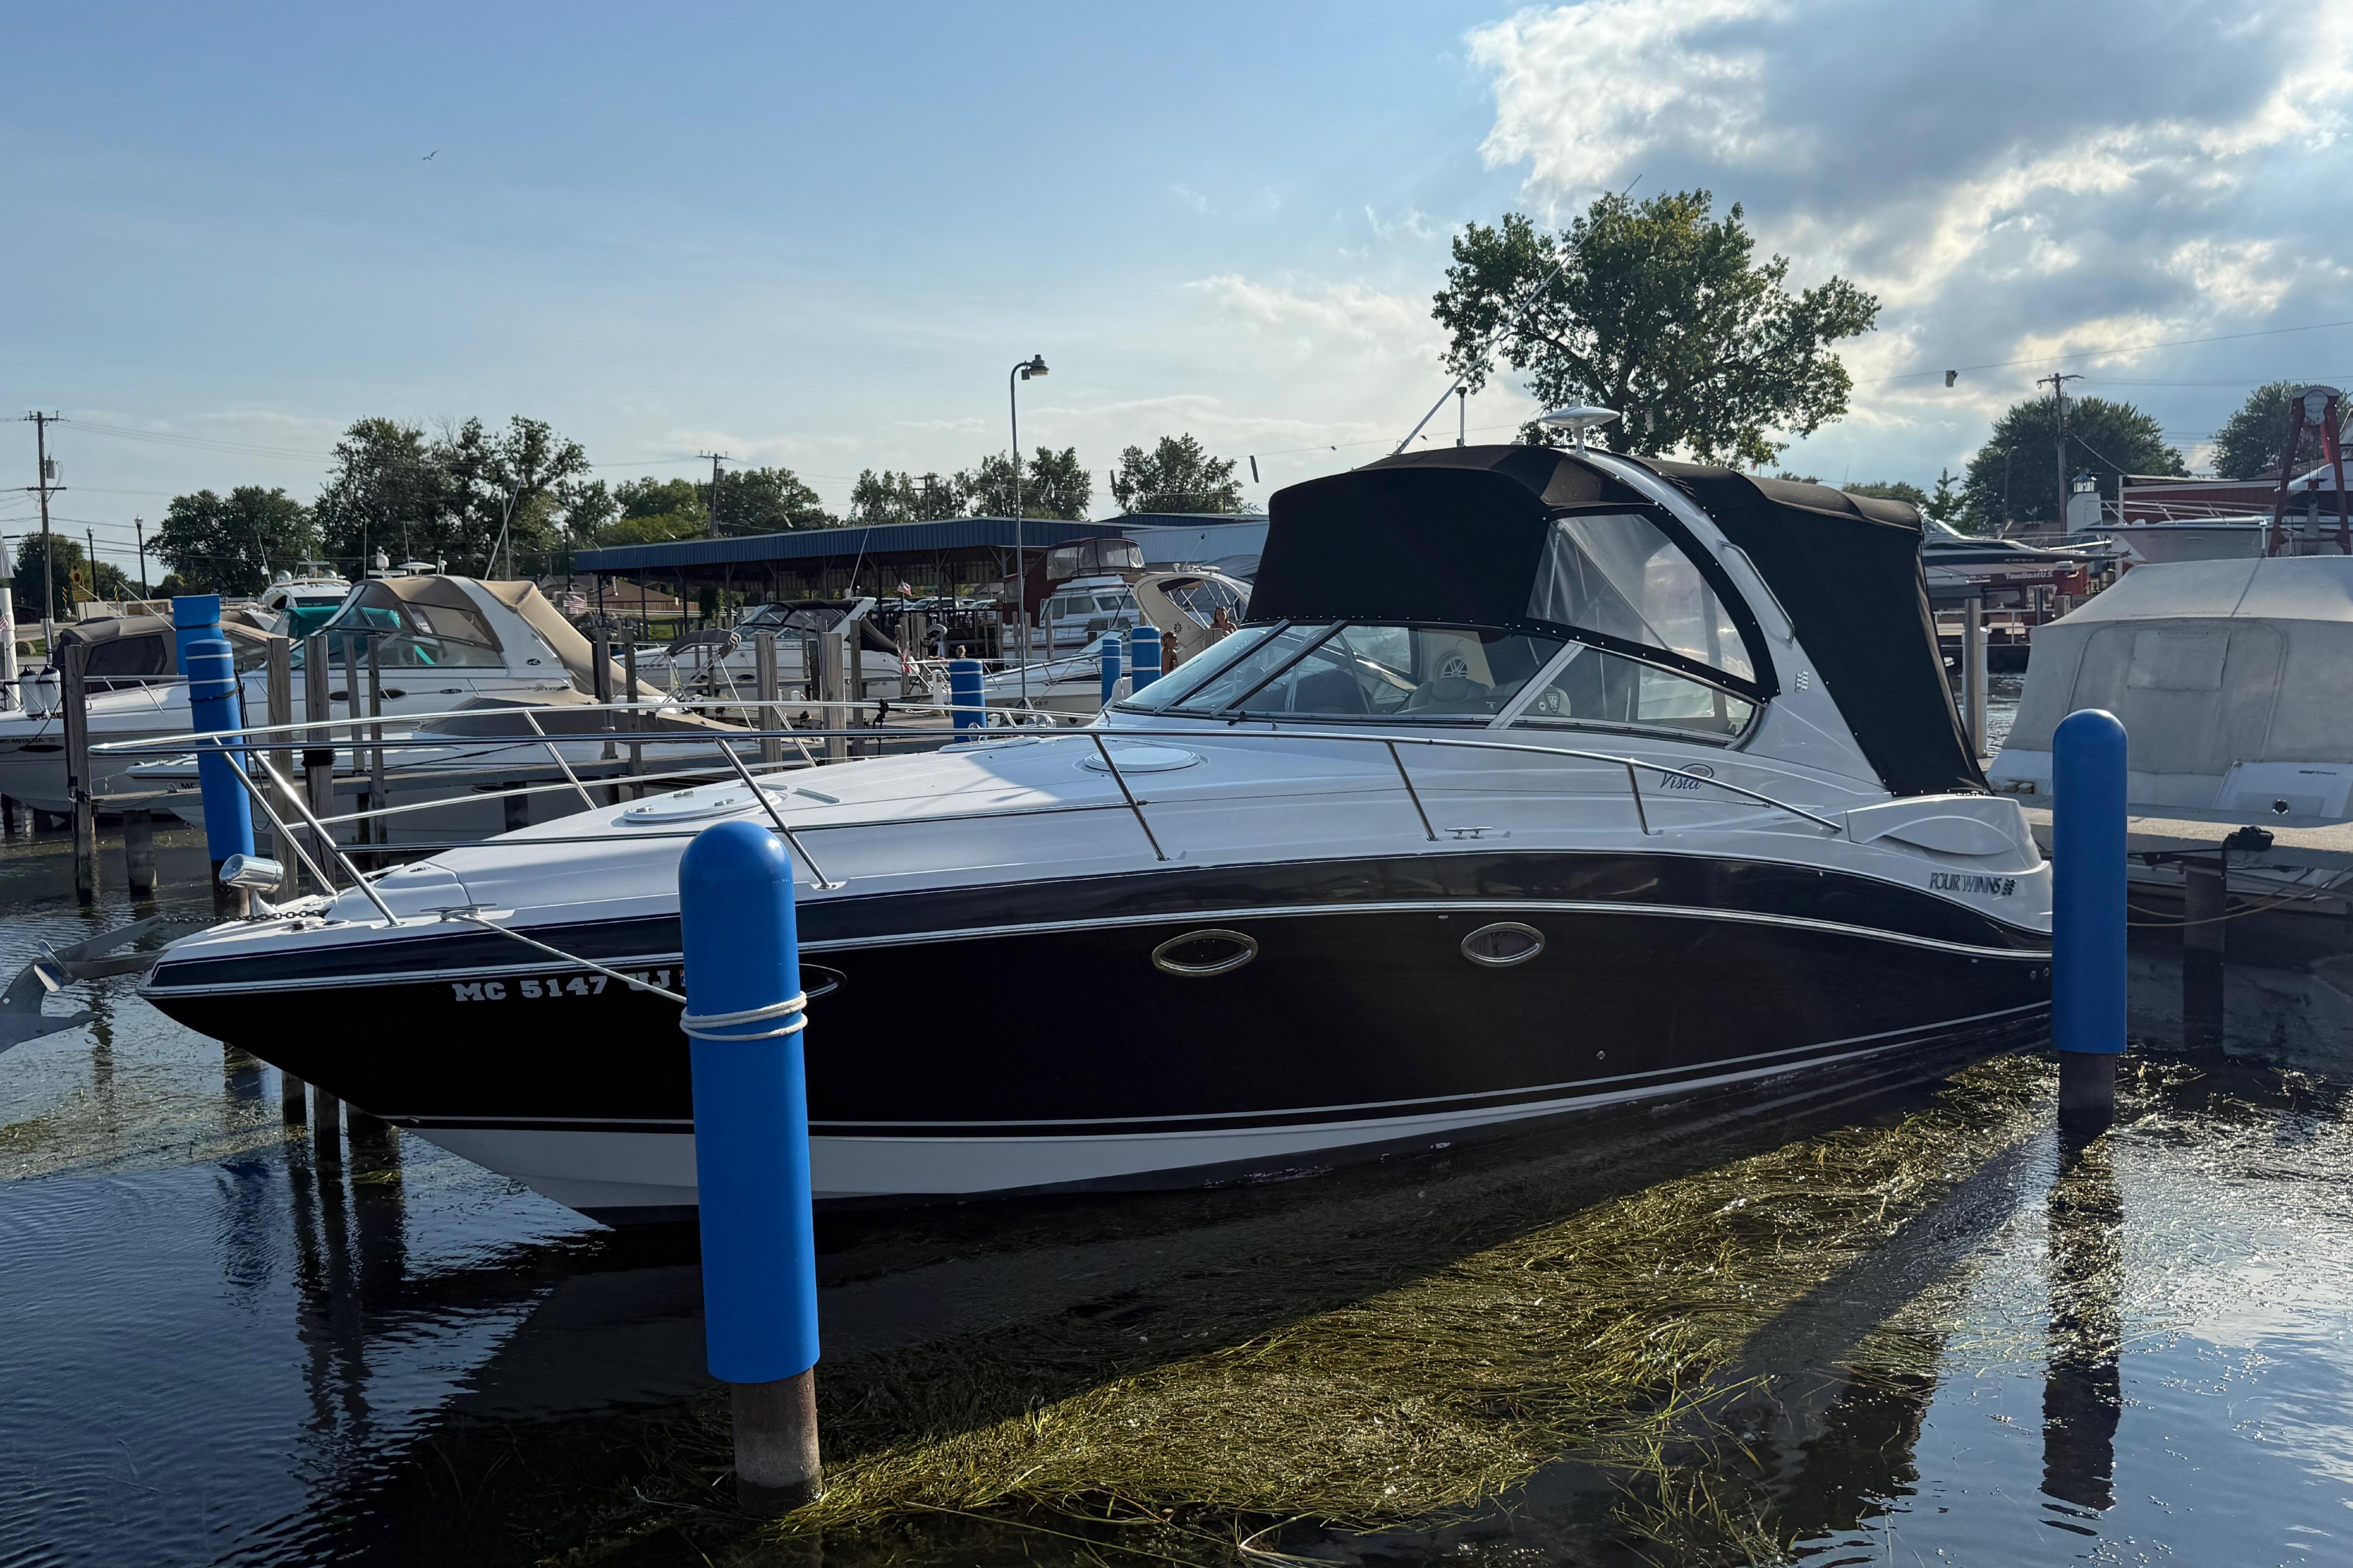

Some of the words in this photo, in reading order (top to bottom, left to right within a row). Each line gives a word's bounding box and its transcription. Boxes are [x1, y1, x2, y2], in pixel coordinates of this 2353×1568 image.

[1660, 772, 1702, 790] Vista
[1929, 872, 1960, 891] FOUR
[1961, 875, 2002, 894] WINNS
[452, 982, 507, 1001] MC
[520, 976, 607, 998] 5147
[624, 970, 671, 991] UJ
